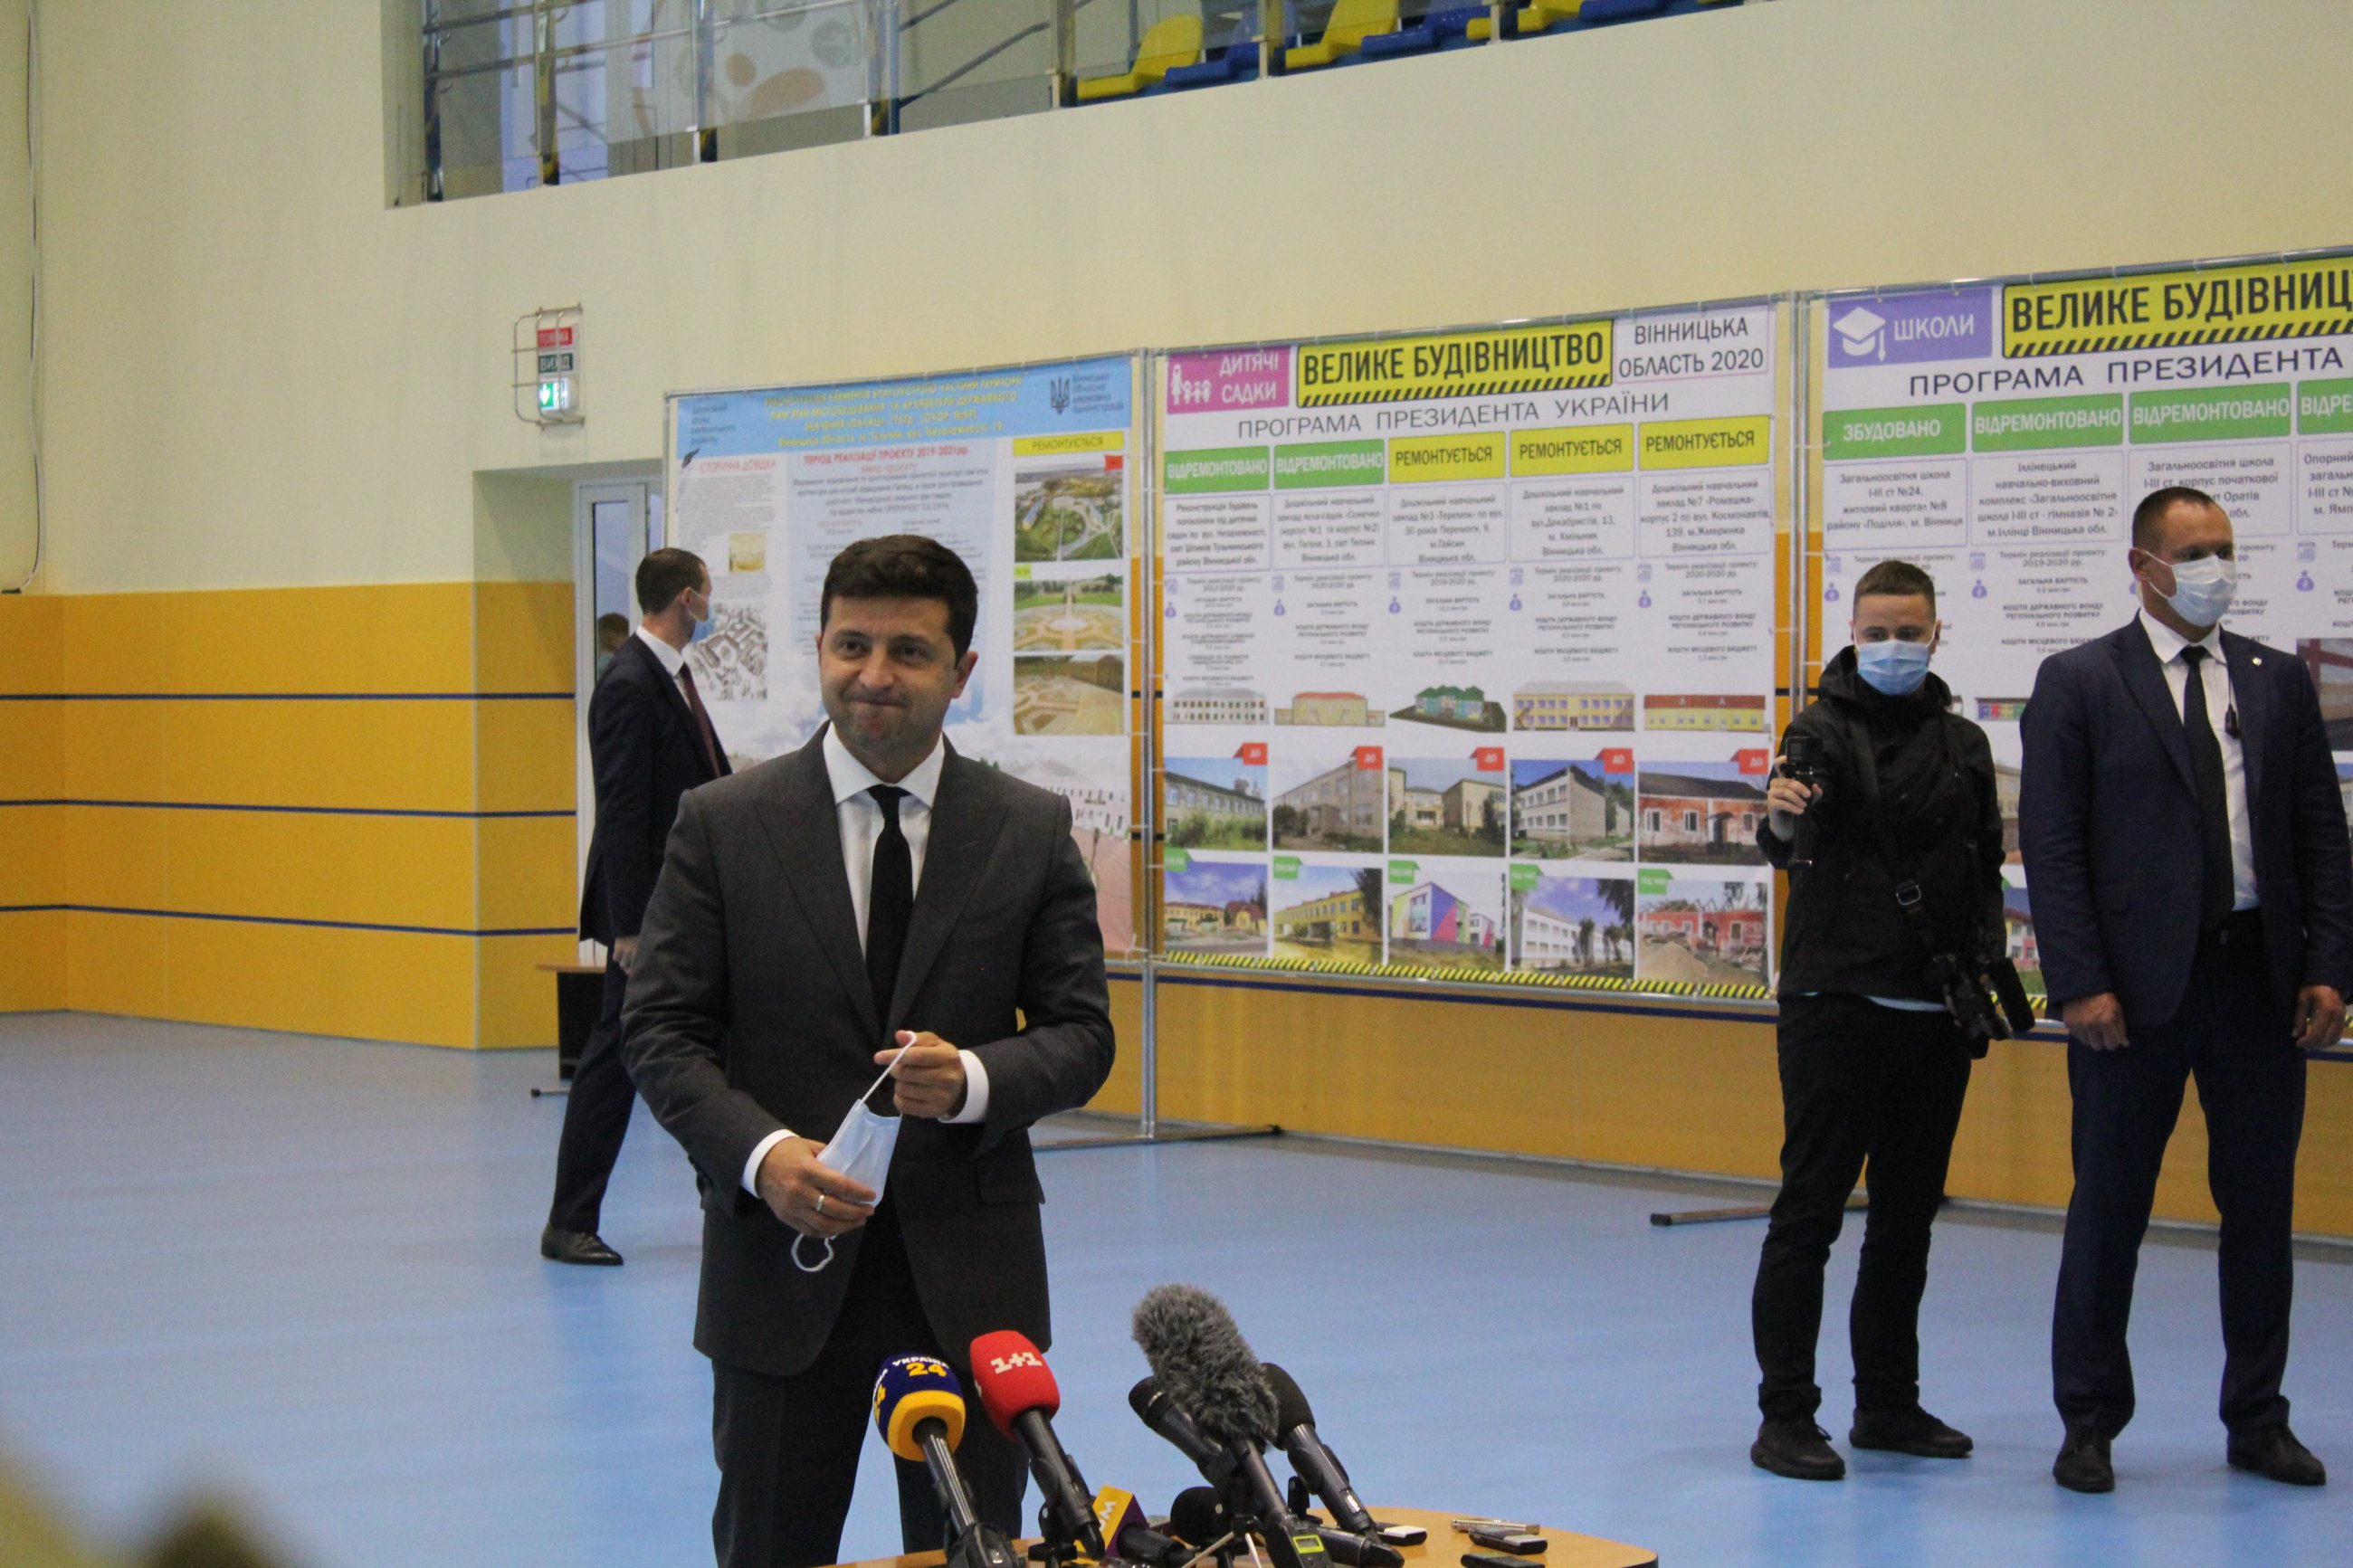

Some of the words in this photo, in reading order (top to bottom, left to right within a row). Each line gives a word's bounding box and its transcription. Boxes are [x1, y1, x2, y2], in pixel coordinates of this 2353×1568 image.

[2013, 288, 2149, 333] ВЕЛИКЕ
[2164, 269, 2353, 322] БУДІВНИЦ
[1634, 318, 1748, 346] ВІННИЦЬКА
[1894, 314, 1974, 342] ШКОЛИ
[1220, 353, 1279, 376] ДИТЯЧІ
[1304, 347, 1404, 385] ВЕЛИКЕ
[1415, 332, 1603, 379] БУДІВНИЦТВО
[1619, 351, 1703, 378] ОБЛАСТЬ
[1711, 348, 1764, 371] 2020
[1910, 364, 2082, 396] ПРОГРАМА
[2108, 347, 2344, 384] ПРЕЗИДЕНТА
[1222, 382, 1276, 404] САДКИ
[1239, 414, 1361, 438] ПРОГРАМА
[1377, 403, 1539, 430] ПРЕЗИДЕНТА
[1555, 390, 1669, 418] УКРАЇНИ
[2133, 397, 2290, 427] ВІДРЕМОНТОВАНО
[1843, 419, 1941, 442] ЗБУДОВАНО
[1975, 408, 2121, 436] ВІДРЕМОНТОВАНО
[1032, 435, 1103, 451] РЕМОНТУЄТЬСЯ
[1519, 438, 1623, 461] РЕМОНТУЄТЬСЯ
[1645, 430, 1755, 453] РЕМОНТУЄТЬСЯ
[1276, 452, 1384, 475] ВІДРЕМОНТОВАНО
[1396, 445, 1493, 467] РЕМОНТУЄТЬСЯ
[2148, 460, 2235, 473] Загальноосвітня
[2239, 456, 2274, 469] школа
[1167, 459, 1268, 480] ВІДРЕМОНТОВАНО
[2018, 461, 2076, 473] Іллінецький
[1840, 471, 1917, 485] Загальноосвітня
[1920, 469, 1950, 480] школа
[1995, 476, 2100, 489] навчально-виховний
[2179, 476, 2215, 489] корпус
[2218, 472, 2279, 486] початкової
[1652, 483, 1704, 494] Дошкільний
[1707, 480, 1758, 490] навчальний
[1885, 489, 1894, 497] ст
[1656, 499, 1685, 508] заклад
[1979, 497, 2026, 508] комплекс
[2224, 490, 2260, 502] Оратів
[1843, 503, 1887, 514] житловий
[1890, 503, 1927, 514] квартал
[1977, 512, 2008, 523] школа
[2030, 511, 2040, 520] ст
[2048, 508, 2090, 519] гімназія
[2229, 508, 2251, 518] обл.
[2313, 506, 2325, 515] м.
[1641, 515, 1671, 525] корпус
[1826, 519, 1861, 531] району
[1924, 516, 1963, 527] Вінниця
[2032, 525, 2085, 537] Вінницька
[2088, 524, 2108, 535] обл.
[1672, 542, 1718, 552] Вінницька
[1999, 550, 2027, 560] Термін
[906, 1362, 948, 1377] 24
[990, 1351, 1043, 1374] 1+1
